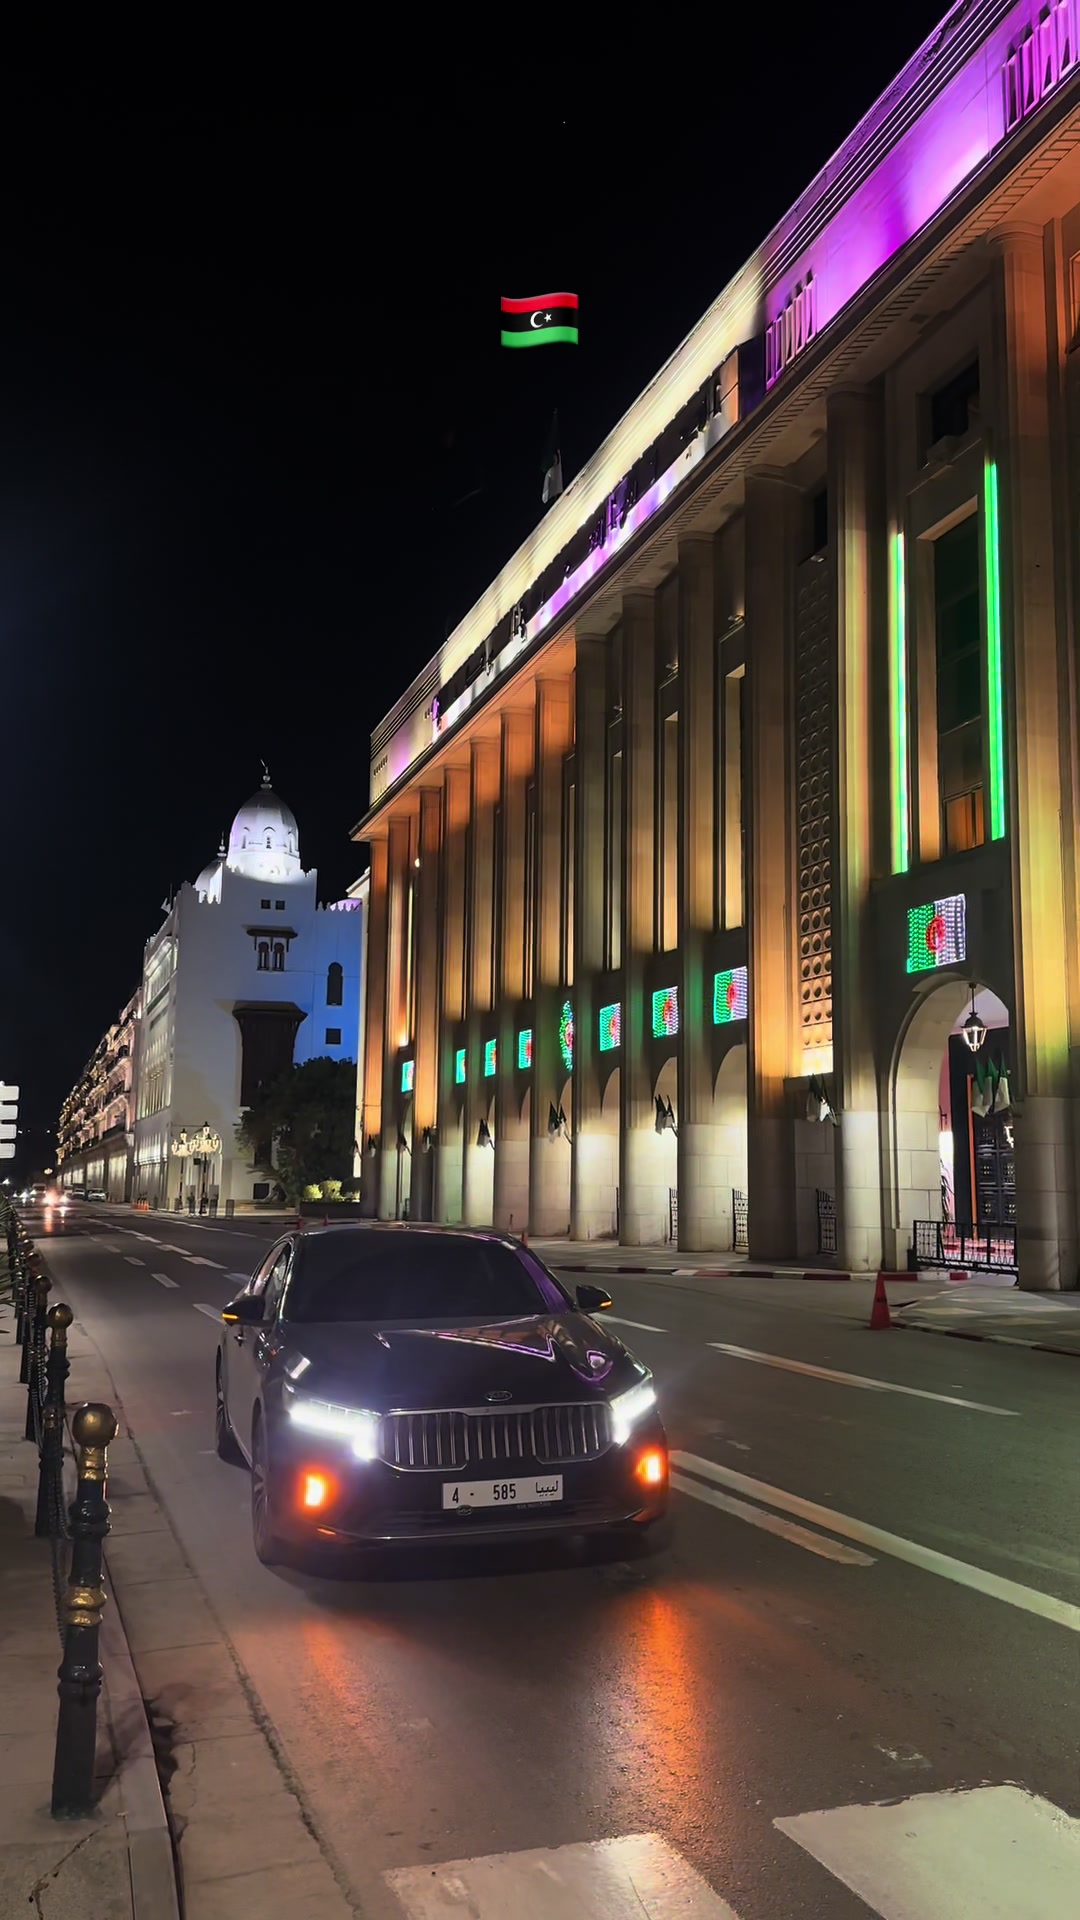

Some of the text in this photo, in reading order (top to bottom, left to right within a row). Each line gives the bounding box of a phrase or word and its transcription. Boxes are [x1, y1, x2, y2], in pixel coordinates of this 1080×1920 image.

[452, 1487, 459, 1503] 4
[493, 1483, 516, 1500] 585
[535, 1480, 559, 1497] ليبيا
